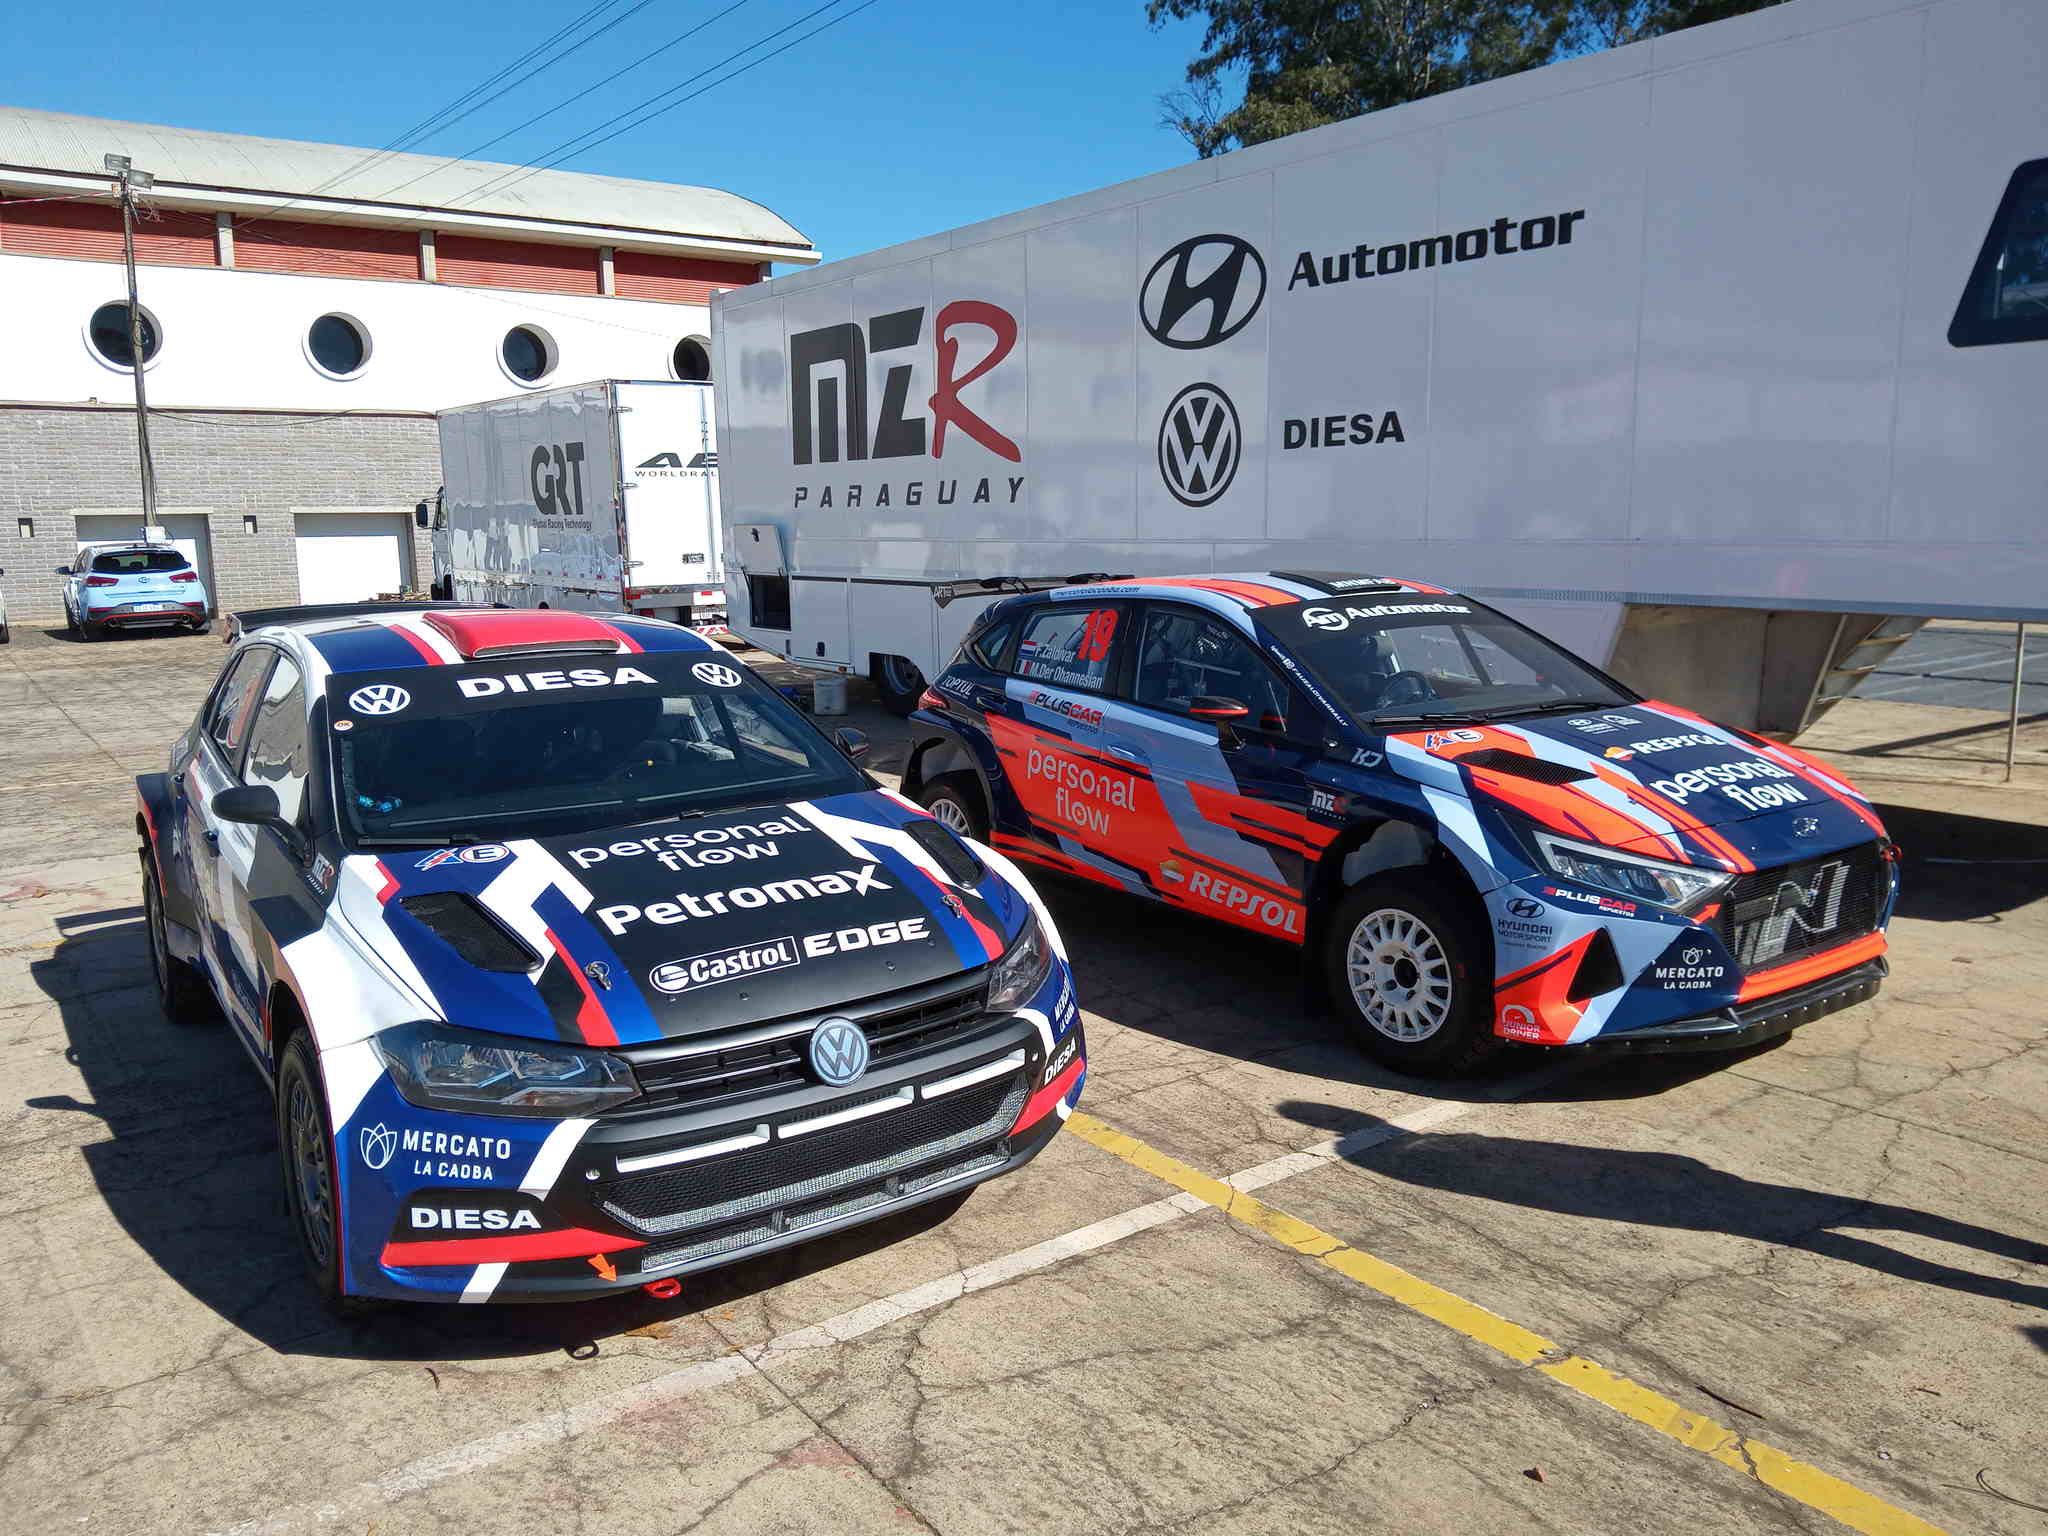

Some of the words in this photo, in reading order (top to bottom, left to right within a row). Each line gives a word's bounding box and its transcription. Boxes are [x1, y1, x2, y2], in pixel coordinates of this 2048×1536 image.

[1288, 210, 1585, 291] Automotor
[1283, 410, 1405, 450] DIESA
[531, 442, 584, 515] GRT
[794, 477, 1025, 508] PARAGUAY
[1345, 603, 1472, 620] Automotor
[1077, 609, 1119, 662] 19
[457, 667, 659, 698] DIESA
[1632, 734, 1727, 754] REPSOL
[1027, 748, 1136, 812] personal
[1650, 759, 1795, 805] personal
[1055, 787, 1110, 835] flow
[1722, 782, 1808, 811] flow
[568, 816, 812, 869] personal
[656, 841, 780, 872] flow
[596, 864, 894, 935] Petromax
[1188, 871, 1298, 934] REPSOL
[1555, 889, 1637, 912] PLUSCAR
[1498, 919, 1553, 935] HYUNDAI
[690, 943, 792, 983] Castrol
[803, 918, 931, 957] EDGE
[1656, 966, 1724, 979] MERCATO
[1663, 981, 1676, 990] LA
[1503, 1028, 1540, 1040] DRIVER
[1044, 1036, 1076, 1086] DIESA
[402, 1129, 511, 1160] MERCATO
[413, 1161, 432, 1175] LA
[438, 1163, 493, 1180] CAOBA
[411, 1207, 542, 1231] DIESA
